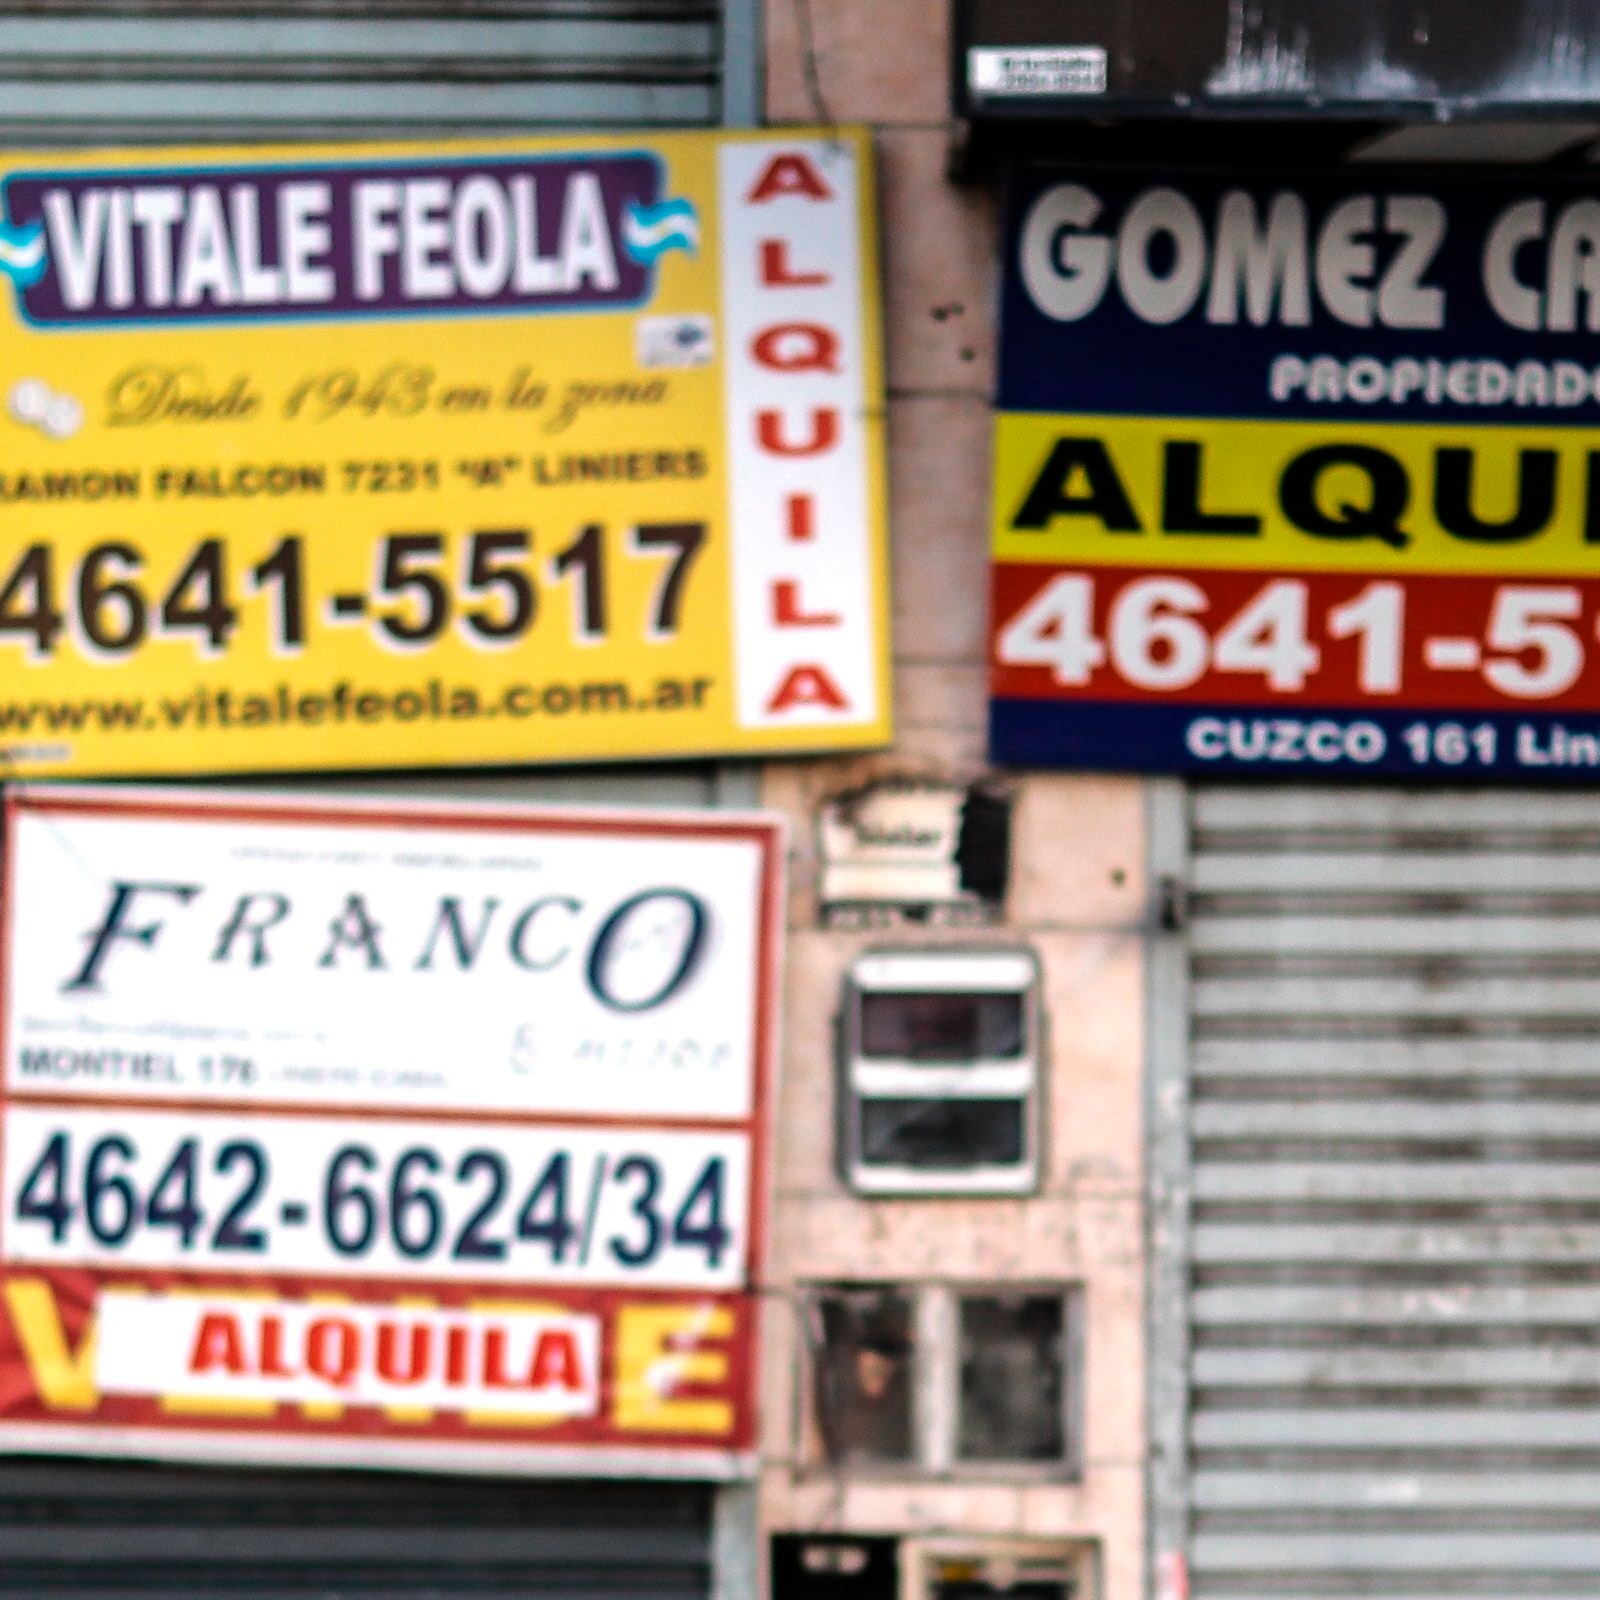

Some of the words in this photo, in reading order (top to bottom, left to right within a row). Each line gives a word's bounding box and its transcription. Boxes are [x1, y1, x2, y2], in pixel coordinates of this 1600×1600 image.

[43, 180, 336, 309] VITALE
[351, 170, 620, 299] FEOLA
[1019, 182, 1448, 330] GOMEZ
[101, 362, 262, 428] Desde
[282, 362, 437, 424] 1943
[442, 383, 491, 411] en
[505, 362, 551, 412] la
[541, 378, 669, 434] zona
[745, 151, 853, 716] ALQUILA
[155, 462, 327, 498] FALCON
[533, 447, 708, 486] LINIERS
[1186, 716, 1386, 764] CUZCO
[1401, 722, 1499, 764] 161
[58, 879, 714, 1017] FRANCO
[16, 1044, 185, 1085] MONTIEL
[14, 1129, 731, 1271] 4642-6624/34
[187, 1310, 586, 1393] ALQUILA
